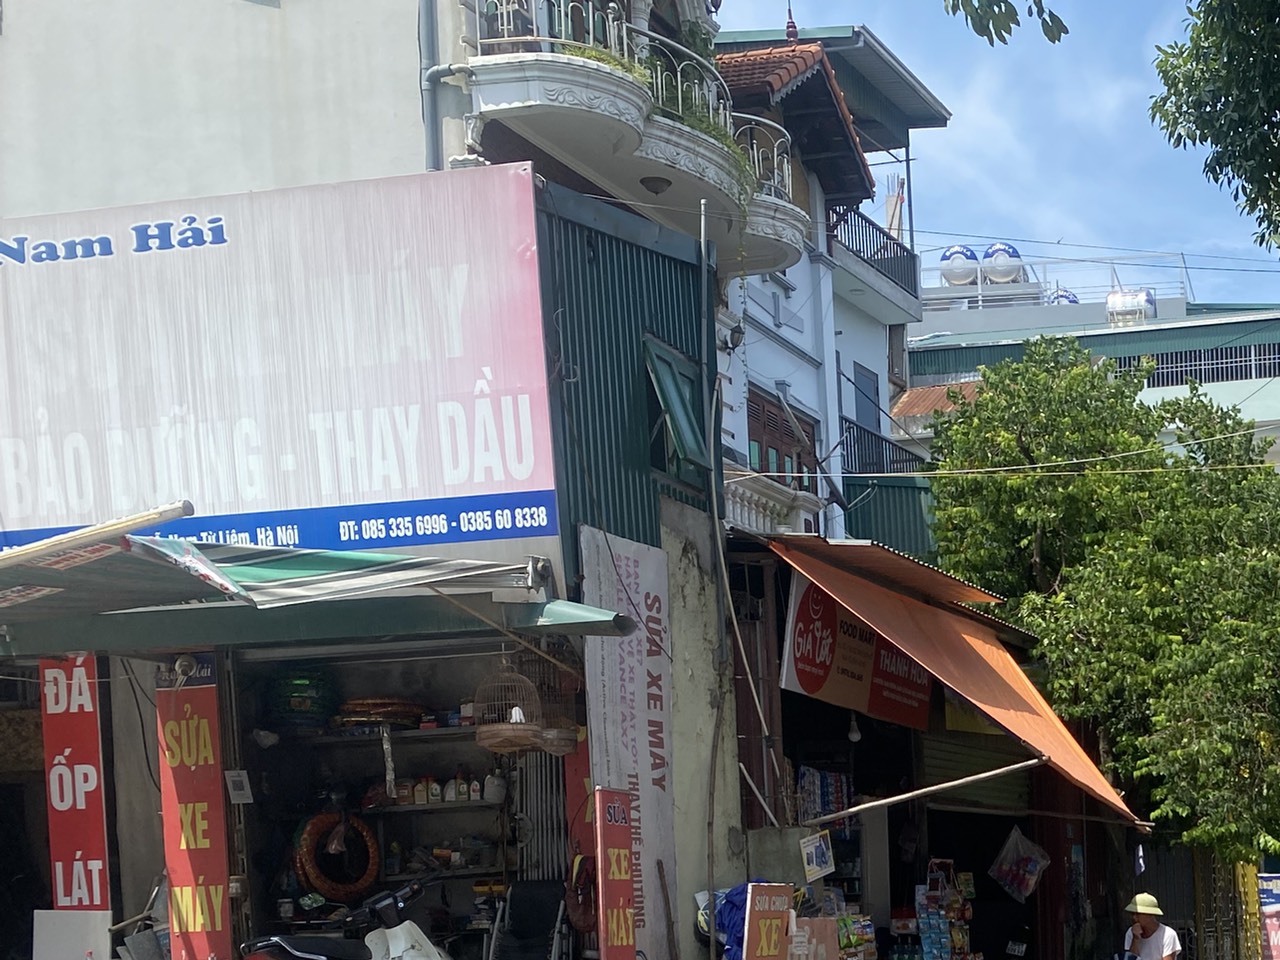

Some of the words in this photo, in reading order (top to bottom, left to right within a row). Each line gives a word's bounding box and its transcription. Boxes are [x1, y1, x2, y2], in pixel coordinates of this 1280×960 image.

[0, 237, 113, 265] Nam
[131, 216, 228, 252] Hải
[2, 407, 95, 518] BẢO
[106, 404, 266, 510] DƯỠNG
[309, 404, 420, 494] THAY
[437, 366, 534, 487] DẦU
[256, 526, 274, 547] Hà
[276, 525, 299, 549] Nội
[339, 520, 359, 541] ĐT:
[361, 519, 387, 540] 085
[389, 516, 413, 538] 335
[415, 514, 448, 535] 6996
[459, 510, 491, 533] 0385
[495, 508, 512, 530] 60
[515, 506, 548, 528] 8338
[644, 592, 668, 657] SỬA
[839, 619, 858, 640] FOOD
[44, 657, 93, 714] ĐÁ
[646, 669, 664, 711] XE
[164, 703, 214, 768] SỬA
[647, 719, 668, 792] MÁY
[50, 748, 97, 811] ỐP
[178, 803, 211, 849] XE
[606, 797, 629, 824] SỬA
[55, 851, 103, 907] LÁT
[608, 848, 630, 880] XE
[171, 876, 224, 933] MÁY
[607, 897, 635, 946] MÁY
[756, 917, 782, 957] XE
